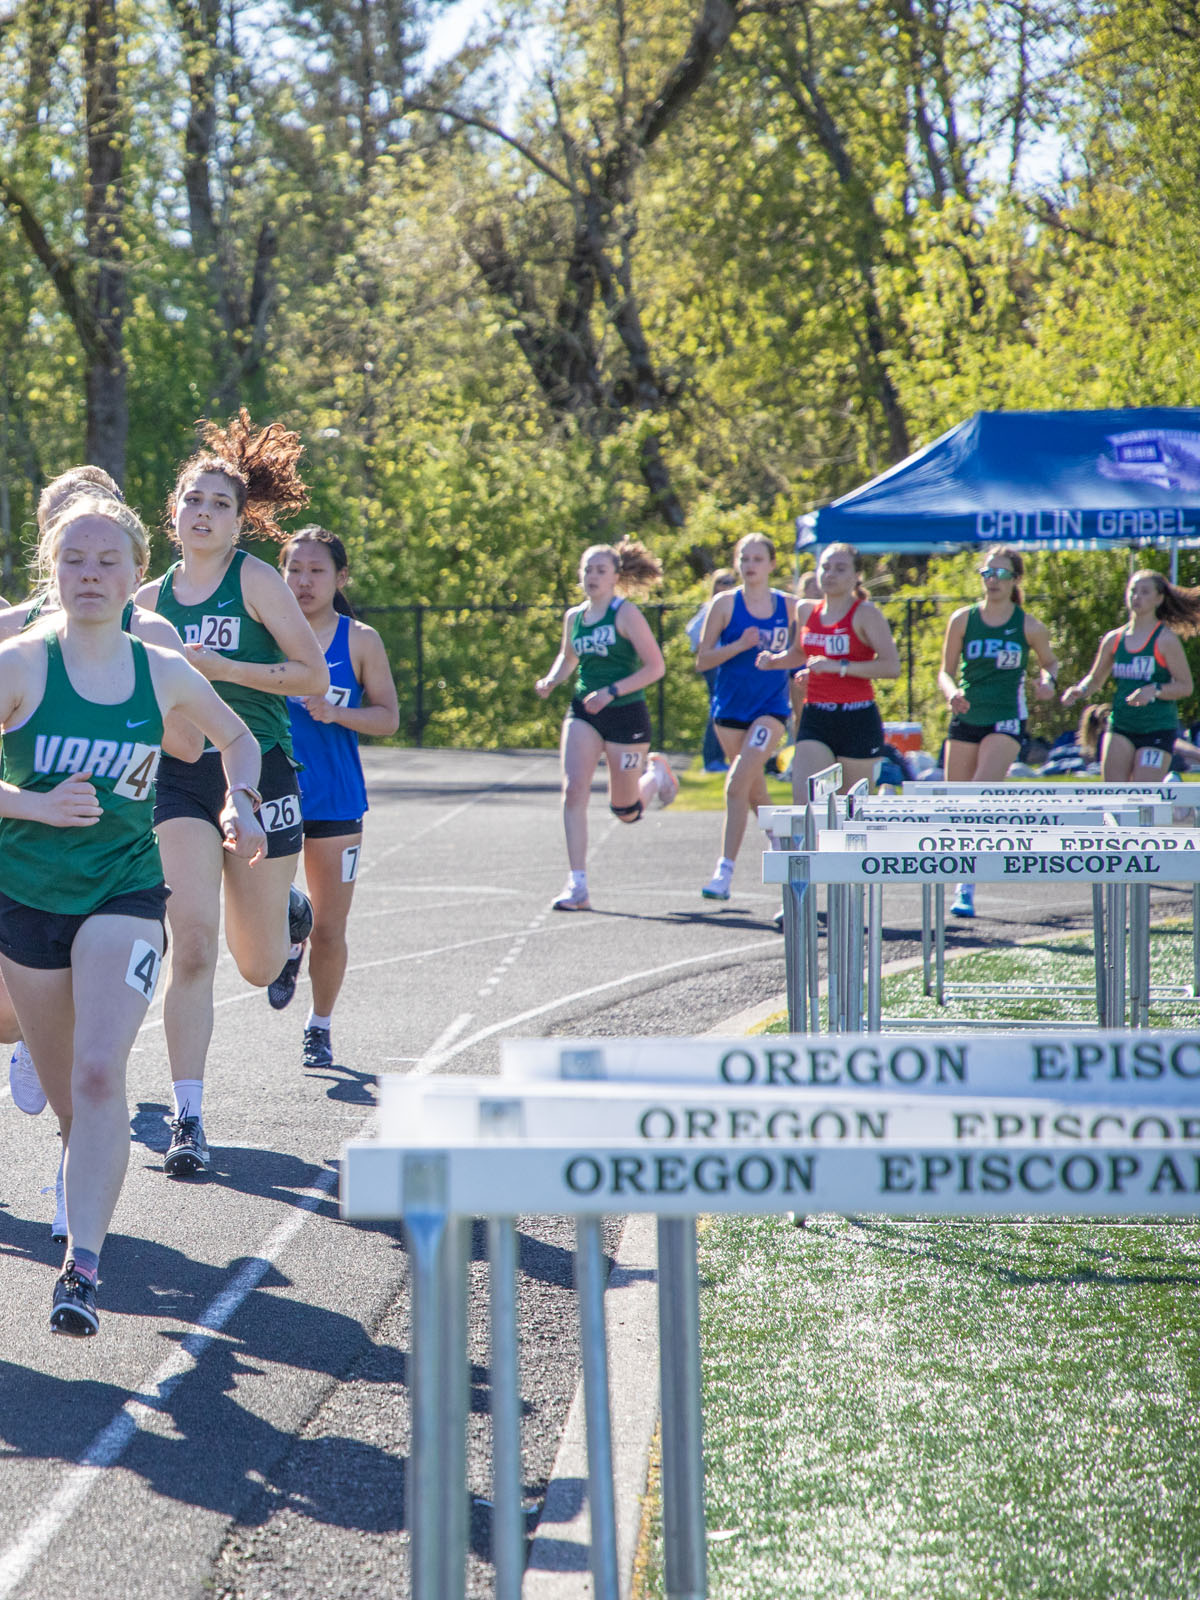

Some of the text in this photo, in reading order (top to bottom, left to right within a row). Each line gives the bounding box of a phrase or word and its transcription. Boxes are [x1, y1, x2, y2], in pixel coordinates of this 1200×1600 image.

[976, 508, 1196, 538] CATLIN GABEL
[204, 617, 231, 647] 26
[595, 627, 611, 644] 22
[775, 628, 787, 649] 9
[829, 635, 845, 652] 10
[1001, 651, 1018, 666] 23
[1137, 657, 1151, 672] 17
[331, 688, 346, 707] 7
[755, 727, 768, 746] 9
[623, 753, 640, 769] 22
[1144, 751, 1160, 766] 17
[125, 751, 156, 797] 4
[266, 797, 295, 830] 26
[918, 837, 1033, 851] OREGON
[347, 847, 359, 880] 7
[861, 855, 1160, 874] OREGON EPISCOPAL
[134, 949, 157, 994] 4
[719, 1045, 970, 1085] OREGON
[639, 1107, 888, 1139] OREGON
[563, 1153, 1200, 1196] OREGON EPISCOPA
